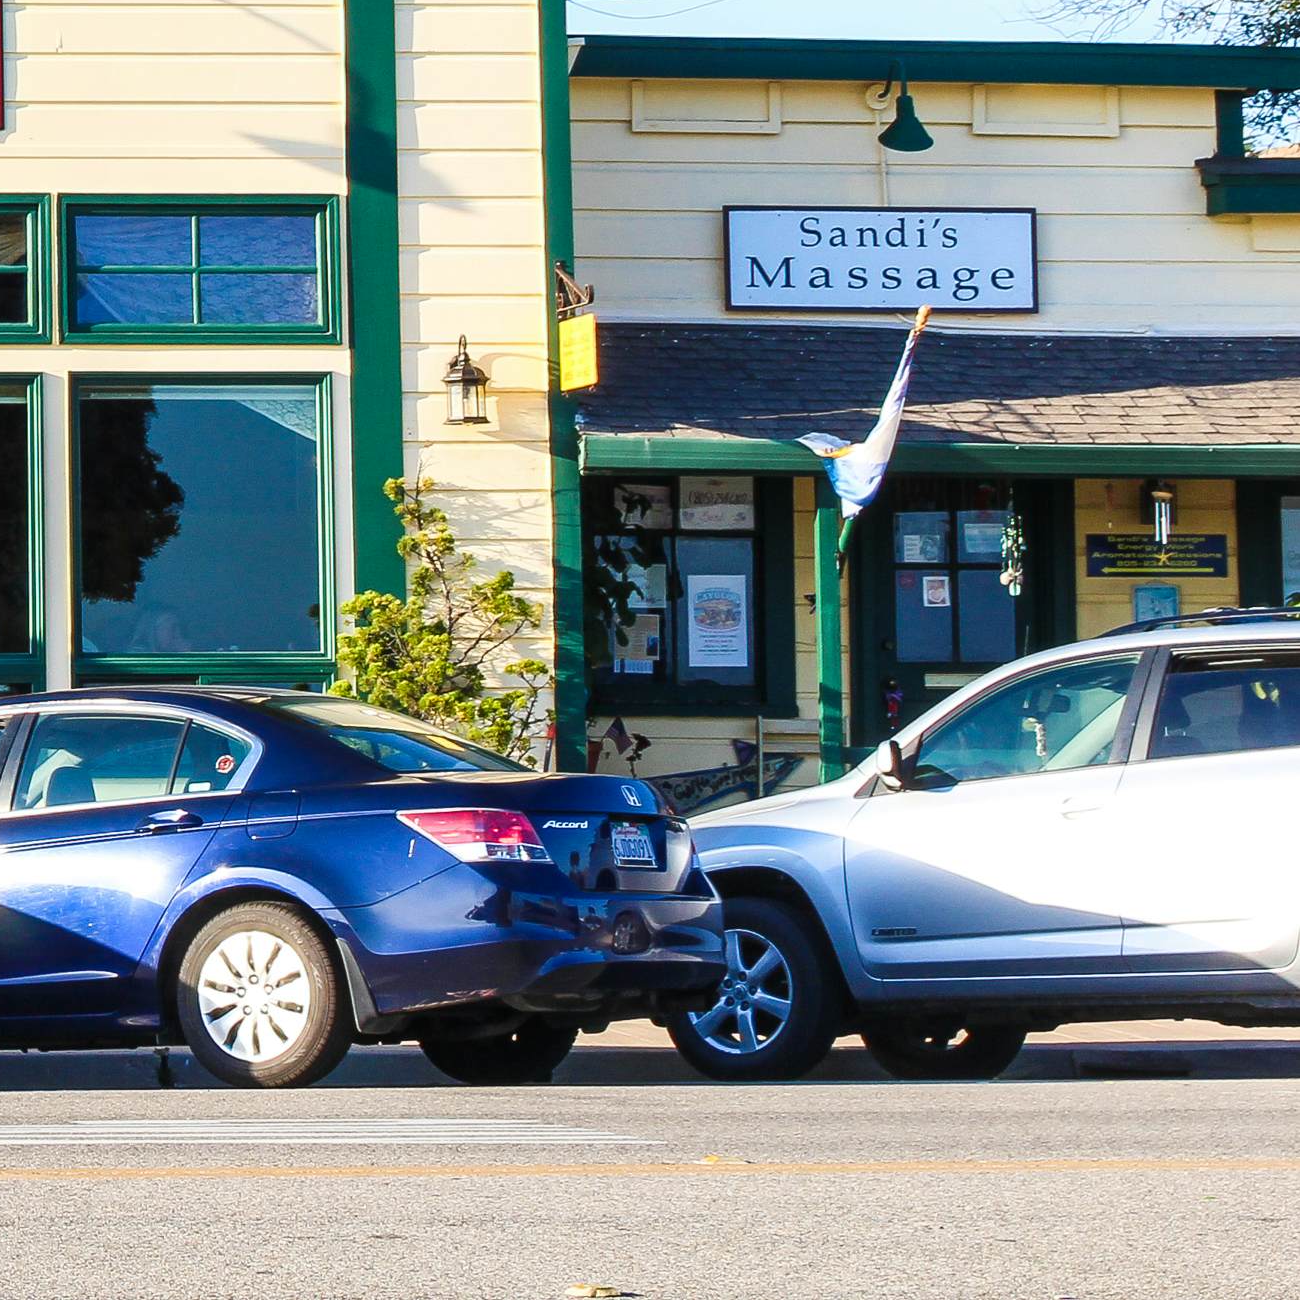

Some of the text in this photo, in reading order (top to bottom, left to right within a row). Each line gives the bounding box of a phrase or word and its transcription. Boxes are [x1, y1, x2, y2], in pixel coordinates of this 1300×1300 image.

[799, 216, 958, 248] Sandi's
[745, 256, 1015, 301] Massage
[542, 821, 588, 829] Accord
